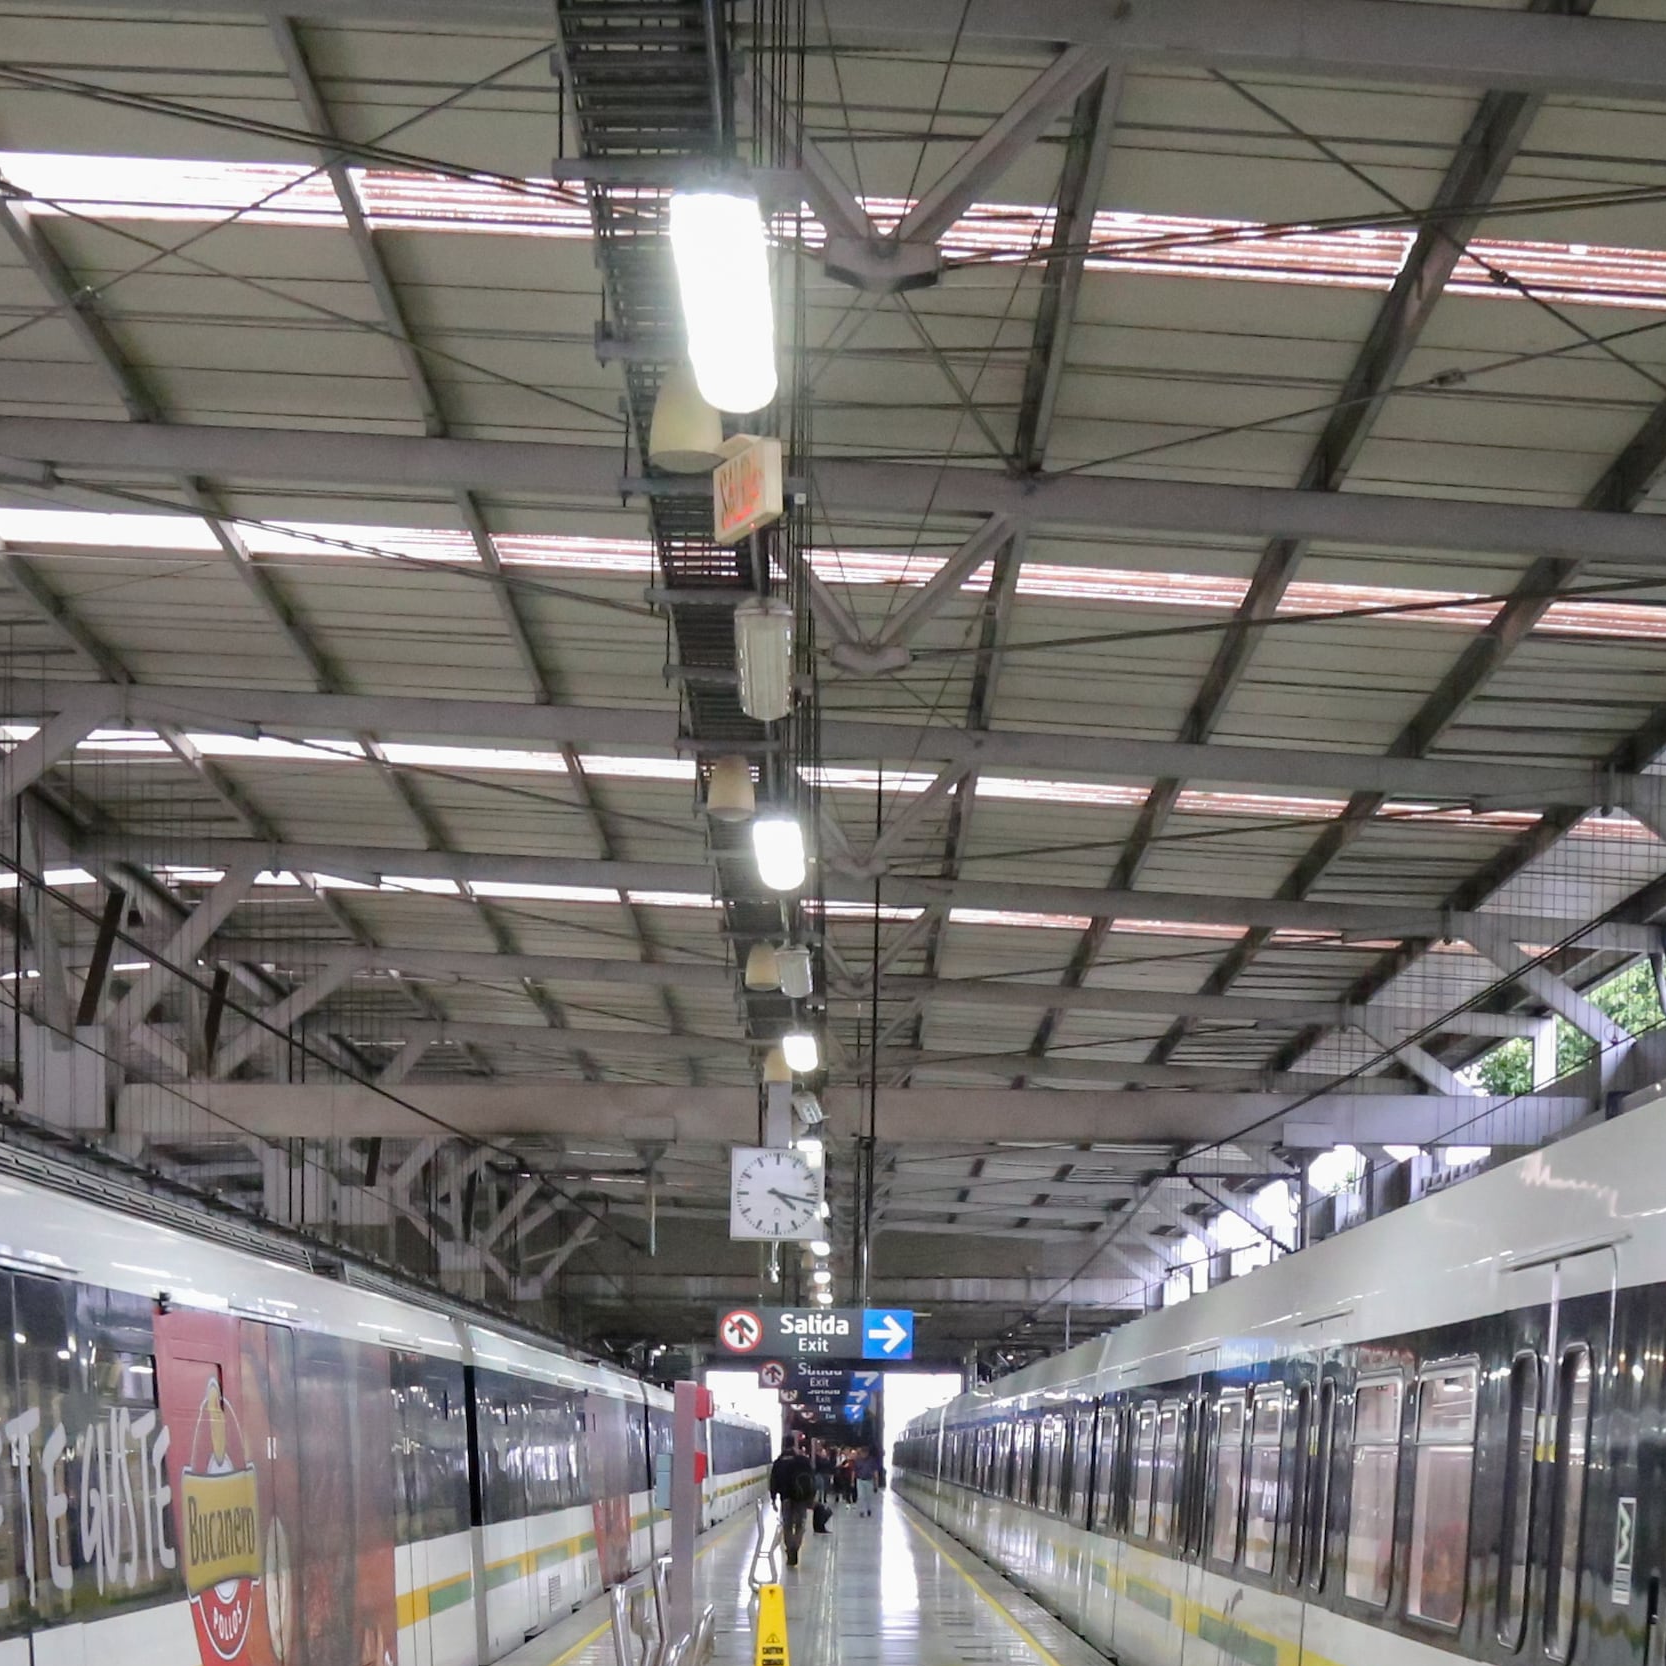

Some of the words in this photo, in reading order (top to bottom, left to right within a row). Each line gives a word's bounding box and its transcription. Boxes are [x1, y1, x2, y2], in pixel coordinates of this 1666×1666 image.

[780, 1313, 850, 1335] Salida
[798, 1338, 829, 1352] Exit
[809, 1376, 830, 1387] Exit
[4, 1406, 74, 1607] TE
[80, 1406, 177, 1597] GUSTE
[188, 1496, 256, 1566] Bucanero
[213, 1600, 243, 1641] POLLOS
